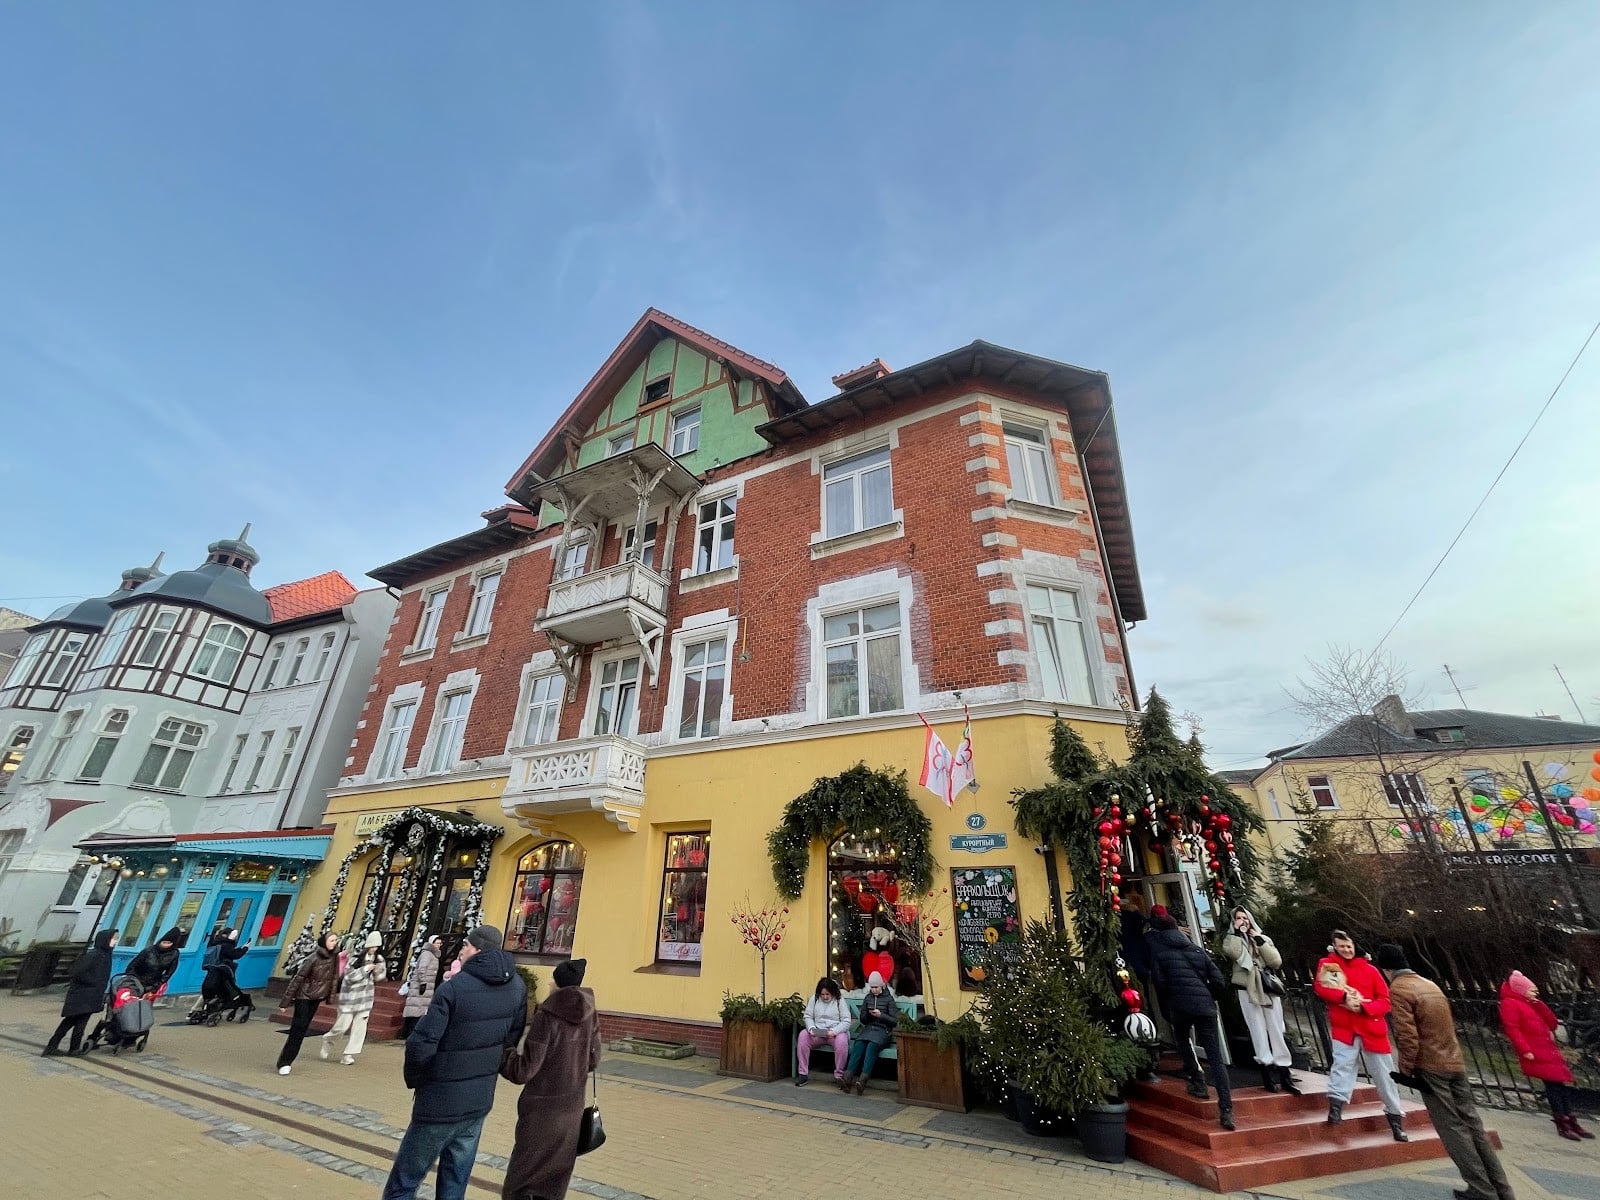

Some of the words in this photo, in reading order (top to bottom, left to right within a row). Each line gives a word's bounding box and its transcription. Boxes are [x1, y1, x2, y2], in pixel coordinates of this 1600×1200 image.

[971, 816, 980, 827] 27
[961, 838, 995, 847] КУРОРТНЫЙ
[956, 884, 1009, 897] БАРАХОЛЬЩИК
[986, 911, 1002, 919] РЕТРО
